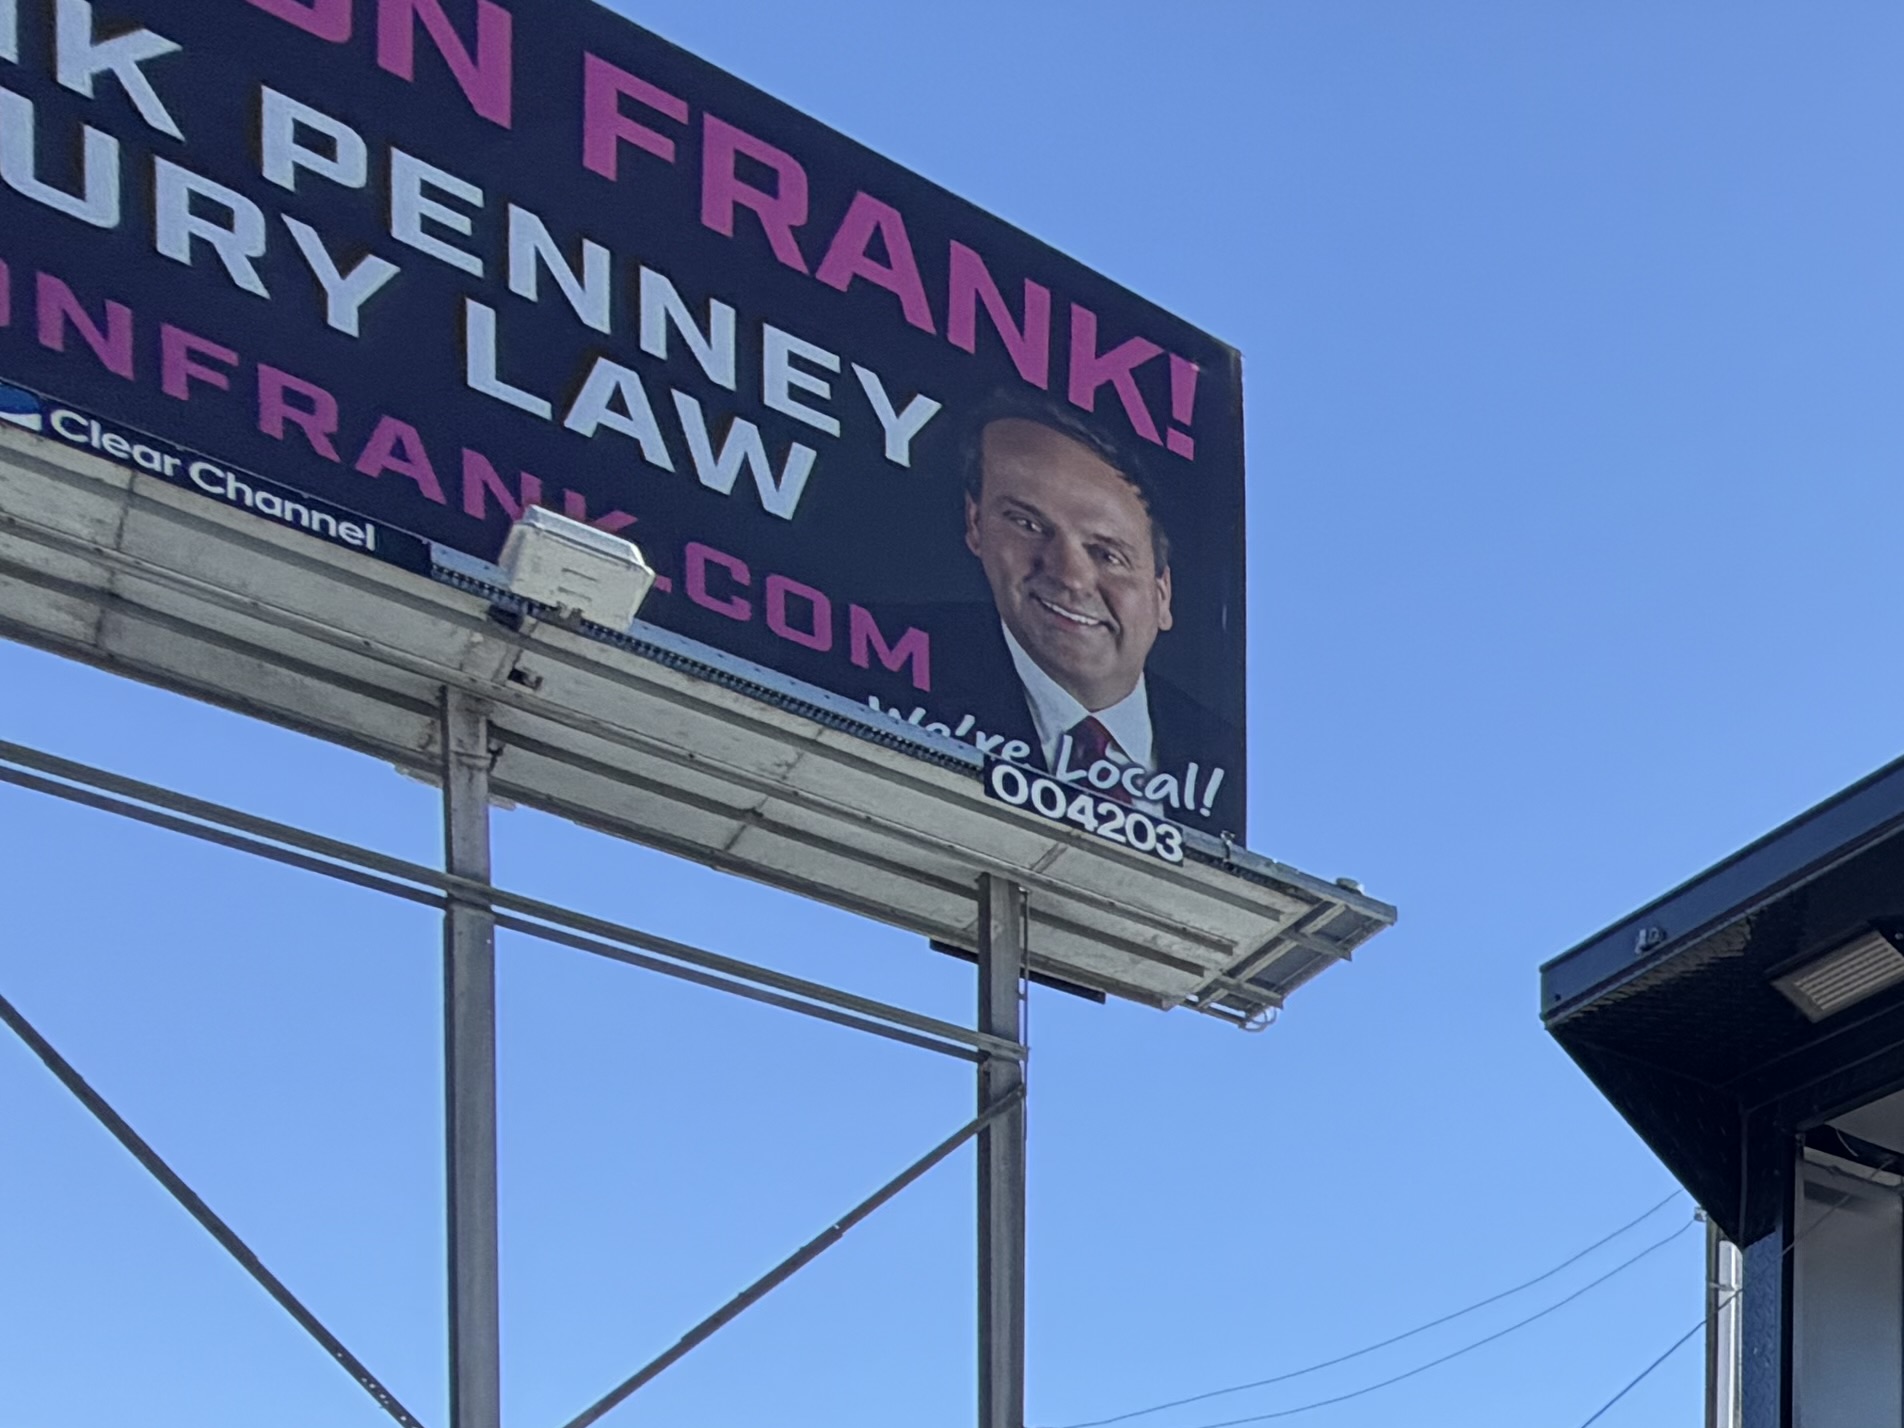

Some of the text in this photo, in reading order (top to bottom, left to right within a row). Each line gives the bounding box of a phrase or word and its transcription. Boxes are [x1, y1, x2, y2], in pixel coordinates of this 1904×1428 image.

[0, 0, 943, 469] K PENNEY
[583, 51, 1201, 461] FRANK!
[50, 407, 378, 552] Clear Channel
[465, 296, 819, 521] LAW
[990, 762, 1185, 864] 004203
[1056, 733, 1226, 818] Local!
